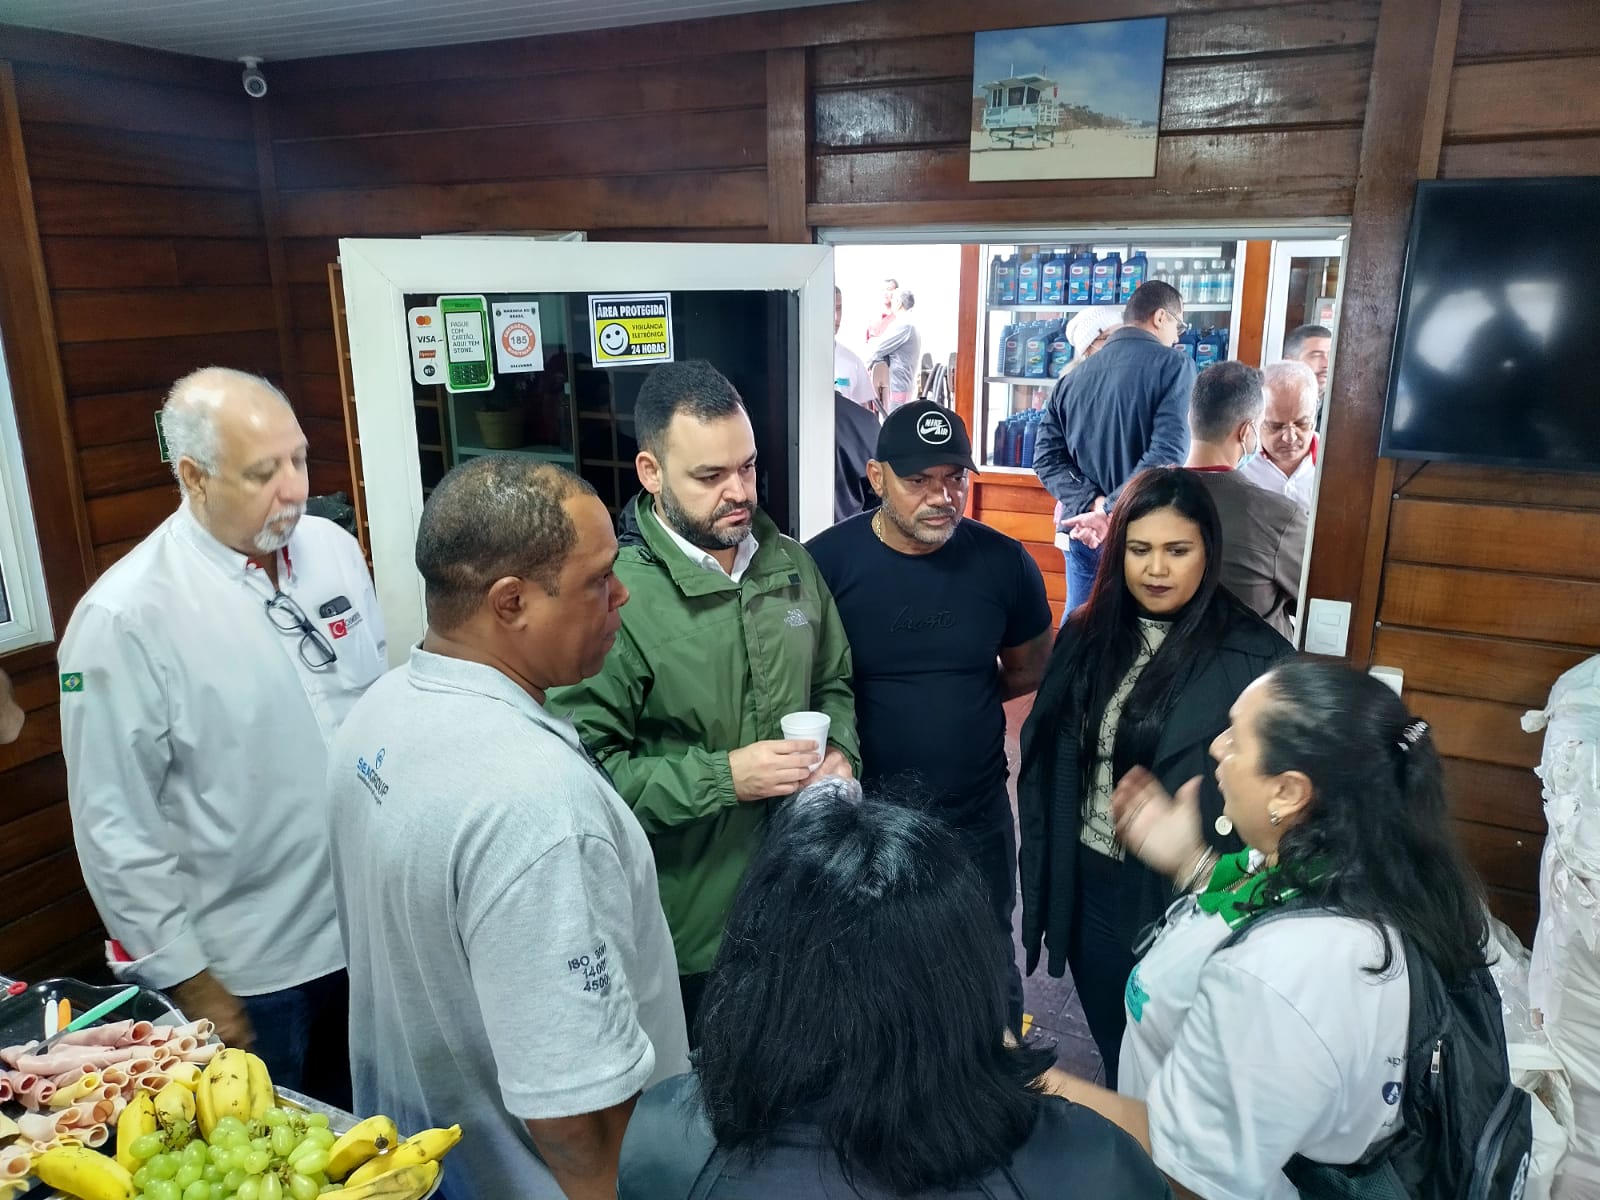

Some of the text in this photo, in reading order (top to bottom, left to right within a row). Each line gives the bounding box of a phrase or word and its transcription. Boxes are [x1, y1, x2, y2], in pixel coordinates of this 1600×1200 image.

[597, 303, 665, 318] ÁREA PROTEGIDA
[416, 335, 436, 343] VISA
[632, 331, 664, 339] ELETRÔNICA
[510, 336, 528, 345] 185
[631, 343, 665, 354] 24 HORAS
[925, 418, 943, 427] NIKE
[934, 427, 948, 436] AIR
